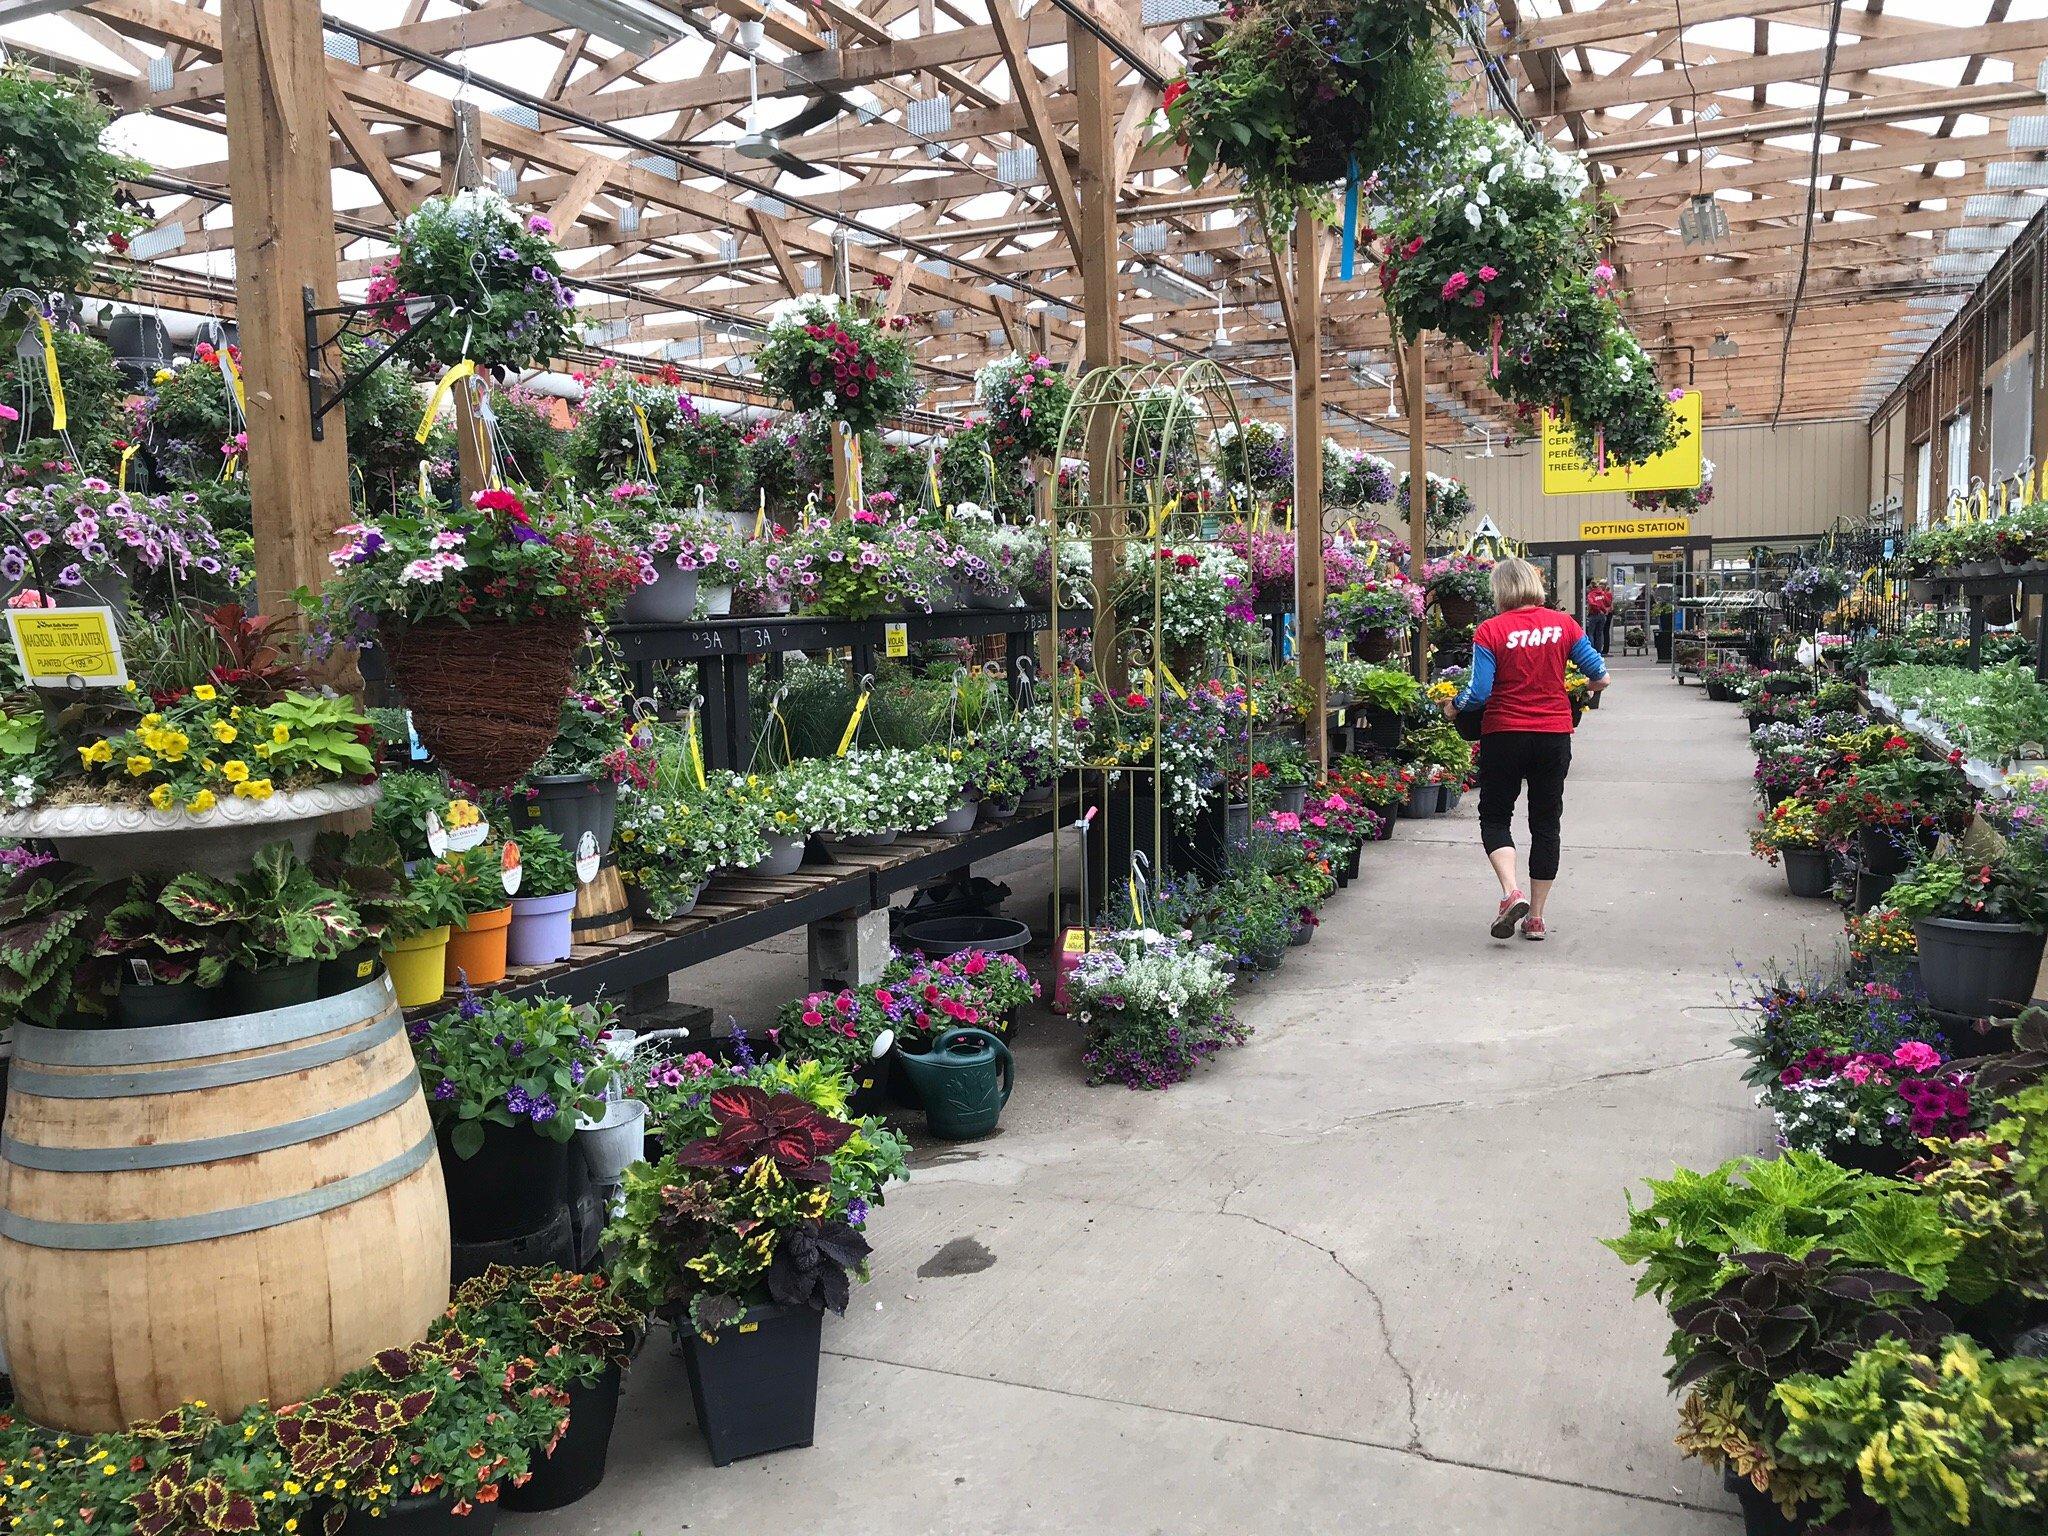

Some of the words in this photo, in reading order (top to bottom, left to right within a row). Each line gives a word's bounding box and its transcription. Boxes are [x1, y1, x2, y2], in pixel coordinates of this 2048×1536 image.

[1548, 462, 1580, 472] TREES
[1584, 523, 1635, 535] POTTING
[1637, 521, 1685, 533] STATION
[22, 633, 56, 648] MAGNESIA
[58, 632, 74, 647] URN
[72, 631, 104, 646] PLANTER
[701, 630, 723, 649] 3A
[754, 628, 772, 648] 3A
[888, 636, 905, 646] VIOLAS
[1506, 626, 1563, 649] STAFF
[37, 658, 62, 668] PLANTED
